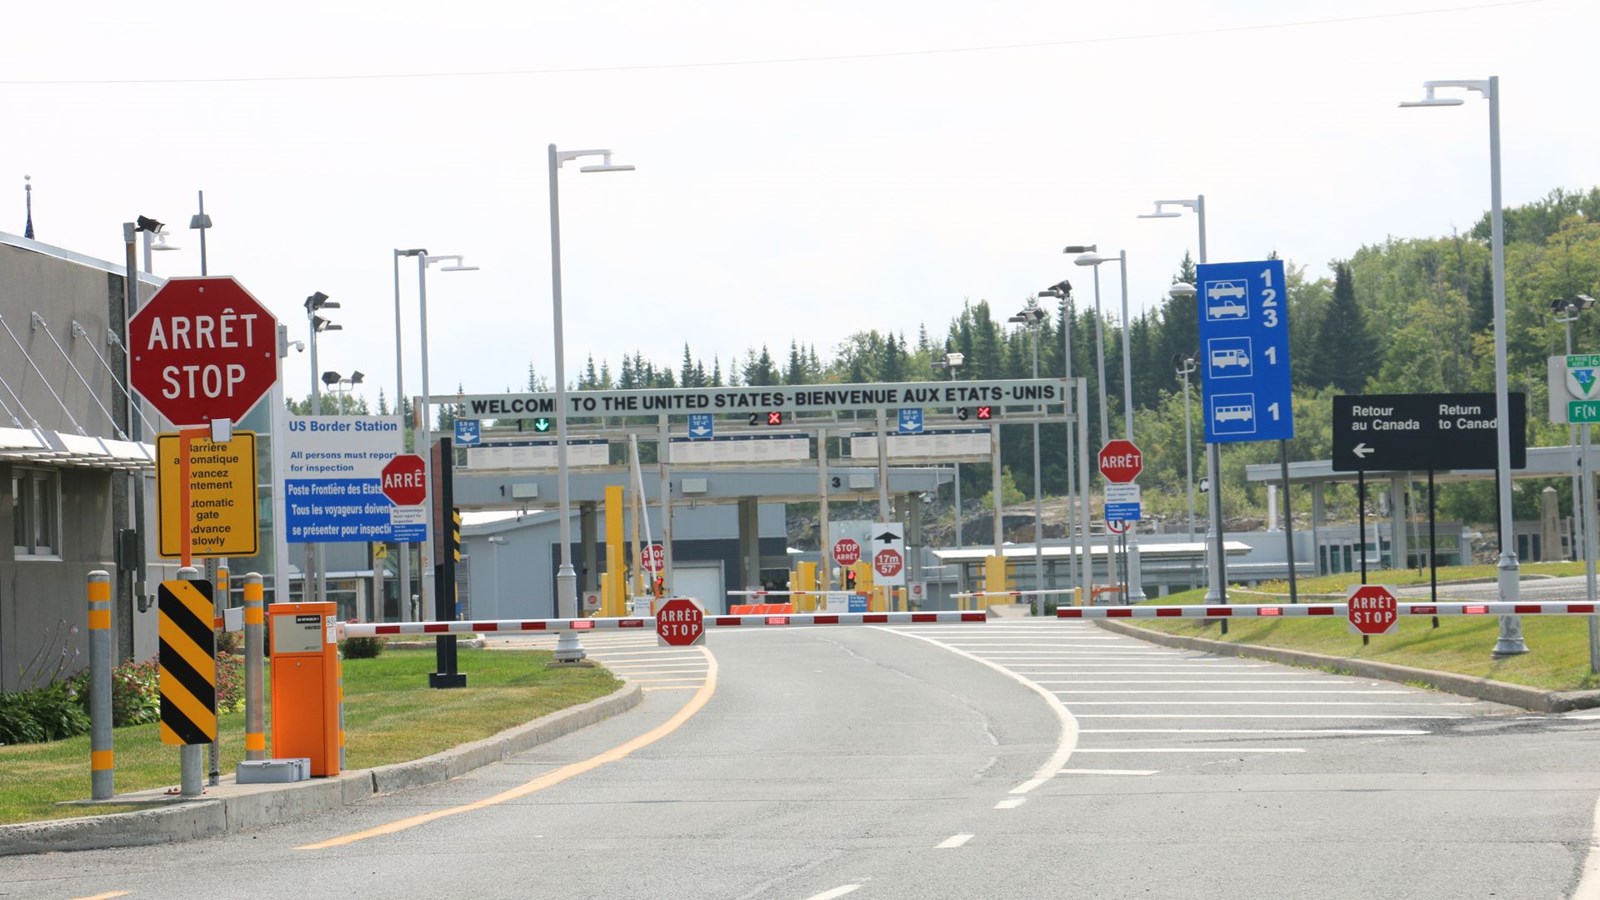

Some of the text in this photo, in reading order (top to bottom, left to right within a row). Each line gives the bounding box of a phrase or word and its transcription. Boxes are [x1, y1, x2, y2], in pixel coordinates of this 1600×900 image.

[1260, 268, 1272, 288] 1
[1261, 288, 1278, 307] 2
[1263, 308, 1279, 328] 3
[147, 307, 258, 350] ARRÊT
[1264, 346, 1276, 365] 1
[161, 364, 246, 399] STOP
[570, 397, 597, 412] TO
[601, 396, 638, 411] THE
[642, 394, 709, 410] UNITED
[903, 387, 940, 403] AUX
[945, 385, 1055, 401] ETATS-UNIS
[958, 407, 969, 421] 3
[1267, 402, 1280, 421] 1
[1352, 405, 1394, 417] Retour
[1439, 404, 1481, 415] Return
[289, 420, 398, 432] US Border Station
[516, 419, 523, 432] 1
[749, 413, 759, 426] 2
[1352, 418, 1420, 431] au Canada
[1438, 417, 1498, 430] to Canad
[174, 455, 239, 465] aomatique
[290, 451, 303, 459] All
[305, 451, 342, 460] persons
[344, 451, 367, 459] must
[1101, 453, 1140, 469] ARRÊT
[190, 470, 229, 478] vancez
[290, 464, 354, 473] for inspection
[190, 480, 233, 490] ntement
[384, 469, 426, 488] ARRÊ
[831, 476, 841, 489] 3
[288, 483, 310, 495] Poste
[311, 482, 345, 495] Frontière
[347, 483, 361, 495] des
[499, 485, 505, 497] 1
[196, 511, 220, 522] gate
[291, 504, 309, 516] Tous
[312, 504, 323, 515] les
[325, 504, 363, 517] voyageurs
[190, 525, 231, 534] dvance
[292, 526, 301, 535] se
[303, 523, 339, 537] présenter
[341, 525, 358, 537] pour
[360, 523, 391, 537] inspecti
[191, 537, 226, 547] slowly
[835, 543, 858, 552] STOP
[643, 549, 665, 559] SOP
[878, 554, 899, 563] 17m
[1353, 594, 1392, 609] ARRÊT
[661, 608, 698, 622] ARRÊT
[1354, 611, 1392, 624] STOP
[662, 624, 699, 636] STOP
